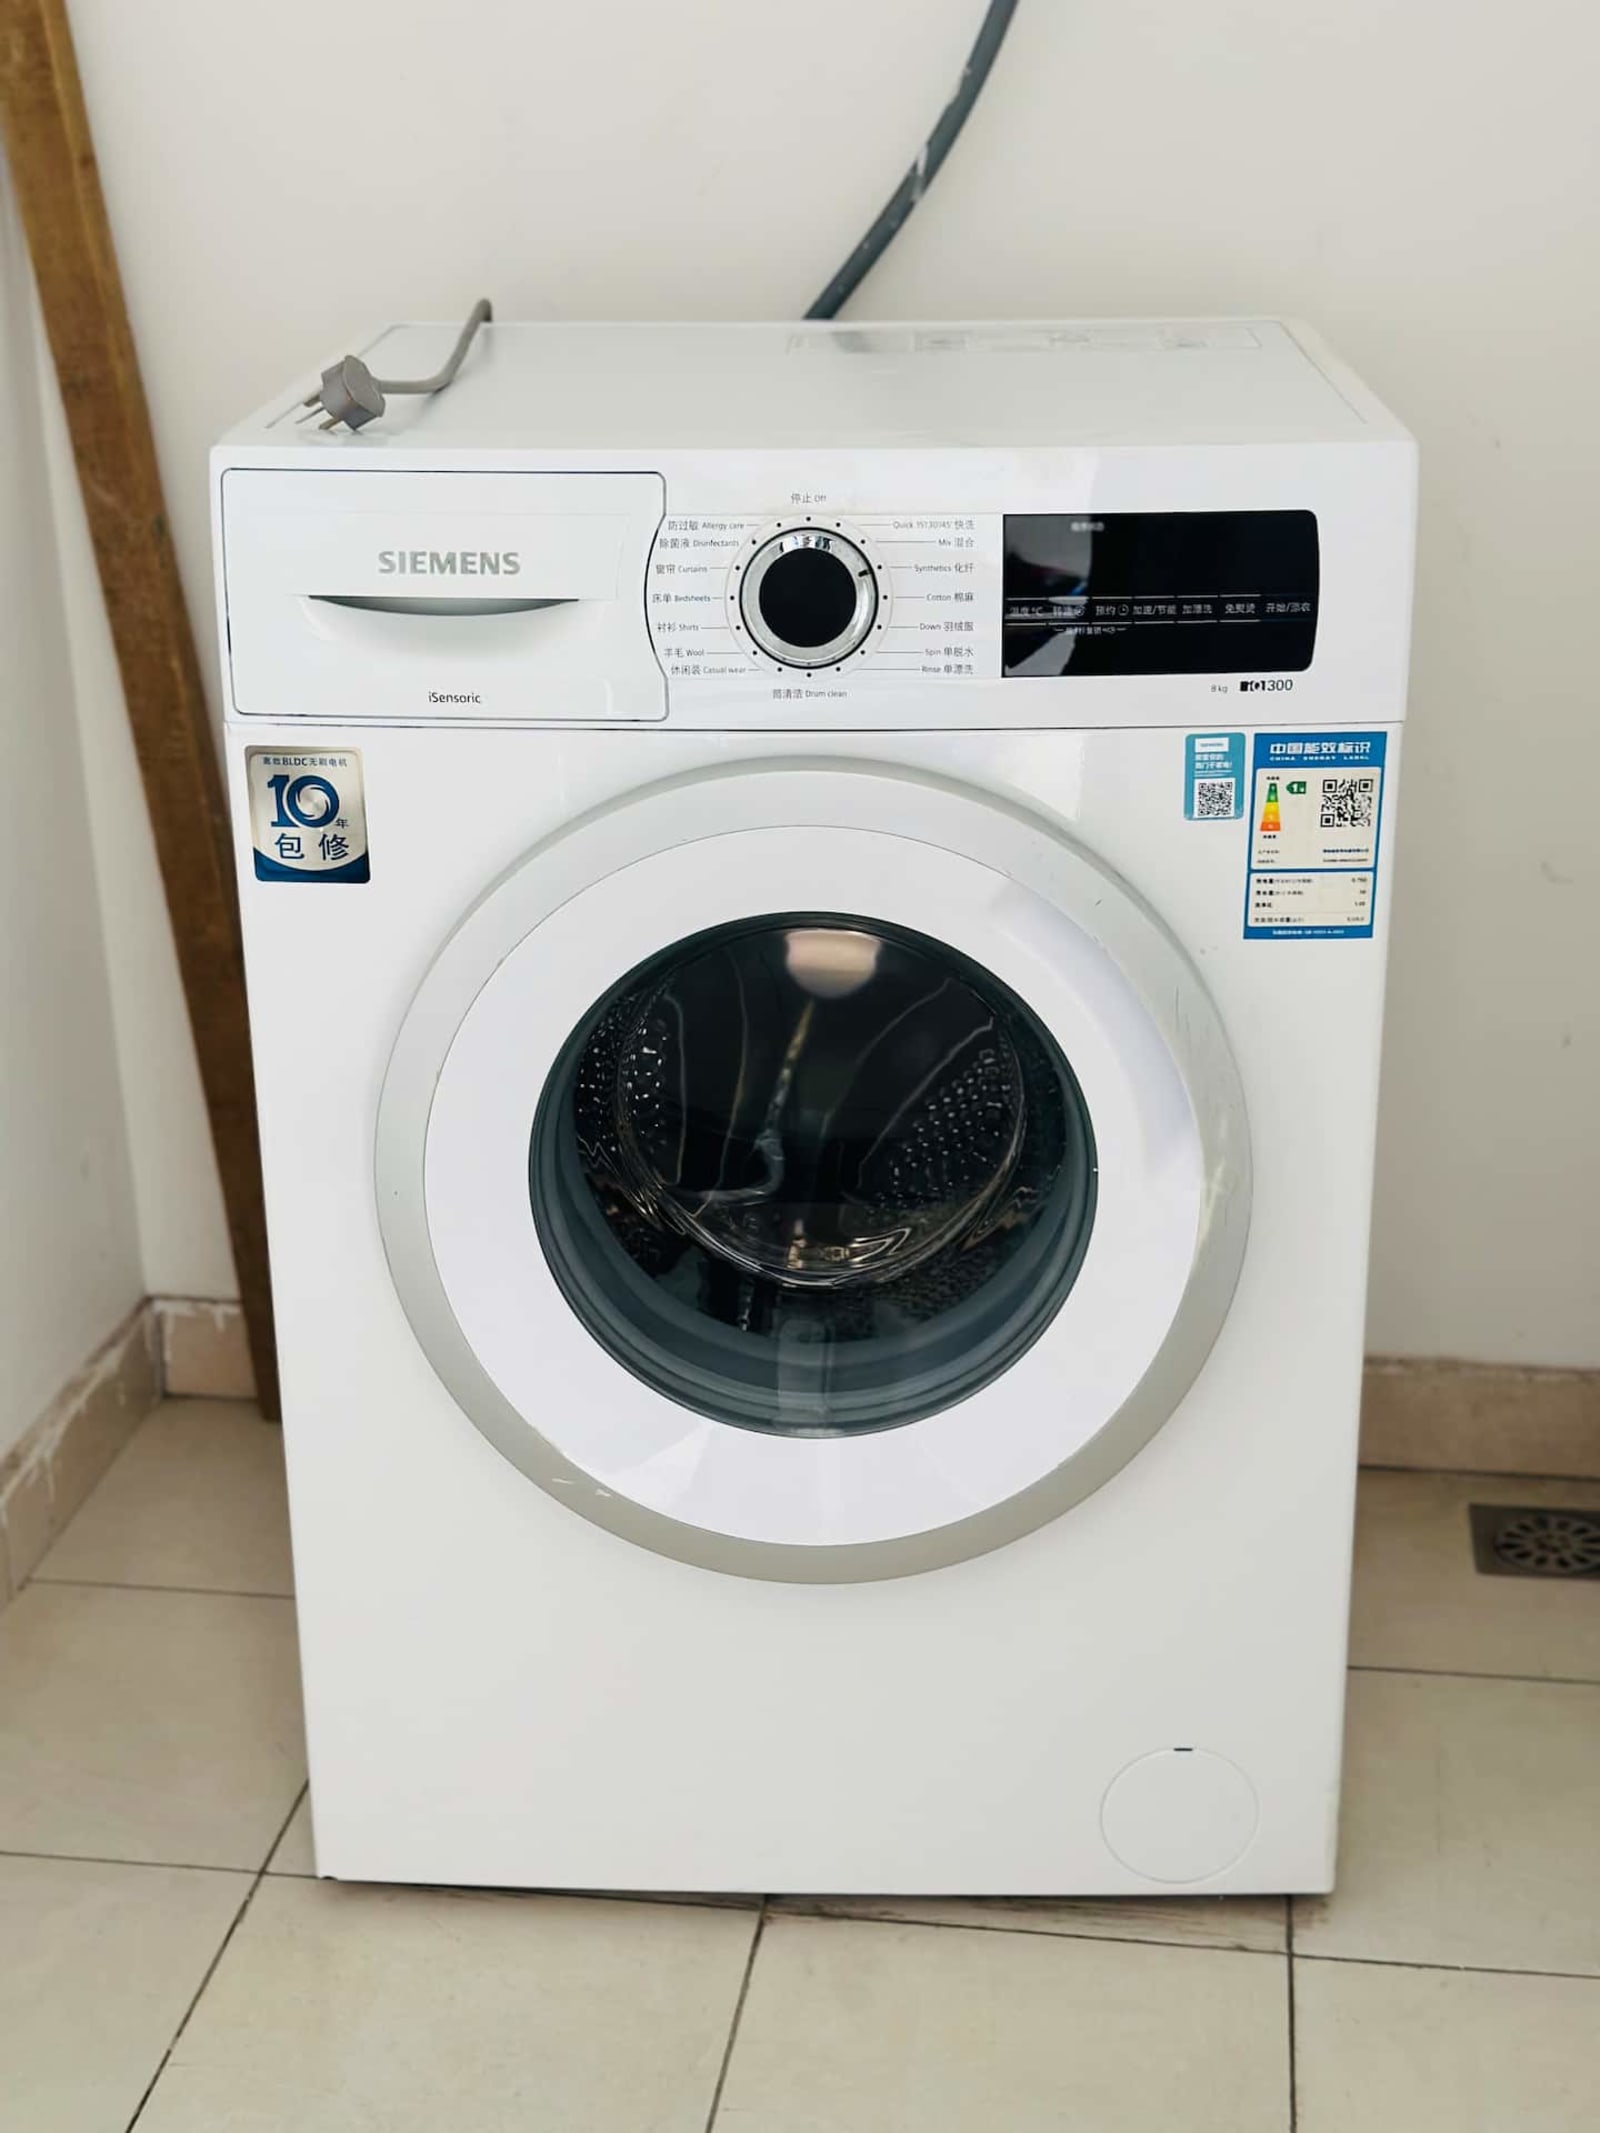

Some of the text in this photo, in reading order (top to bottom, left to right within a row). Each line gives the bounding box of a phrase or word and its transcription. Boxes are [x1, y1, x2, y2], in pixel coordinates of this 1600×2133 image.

[791, 494, 812, 504] 停止
[668, 520, 698, 531] 防过敏
[702, 521, 727, 531] Allergy
[893, 520, 913, 530] Quick
[955, 519, 975, 531] 快洗
[659, 538, 690, 549] 除菌液
[939, 539, 951, 547] Mix
[378, 550, 521, 575] SIEMENS
[914, 562, 975, 574] Synthetics 化纤
[653, 593, 672, 604] 床单
[927, 593, 951, 601] Cotton
[679, 623, 699, 631] Shirts
[944, 621, 974, 632] 羽绒服
[686, 648, 704, 656] Wool
[925, 648, 941, 656] Spin
[703, 666, 726, 674] Casual
[922, 665, 941, 673] Rinse
[428, 691, 481, 704] iSensoric
[805, 689, 825, 698] Drum
[827, 689, 847, 698] clean
